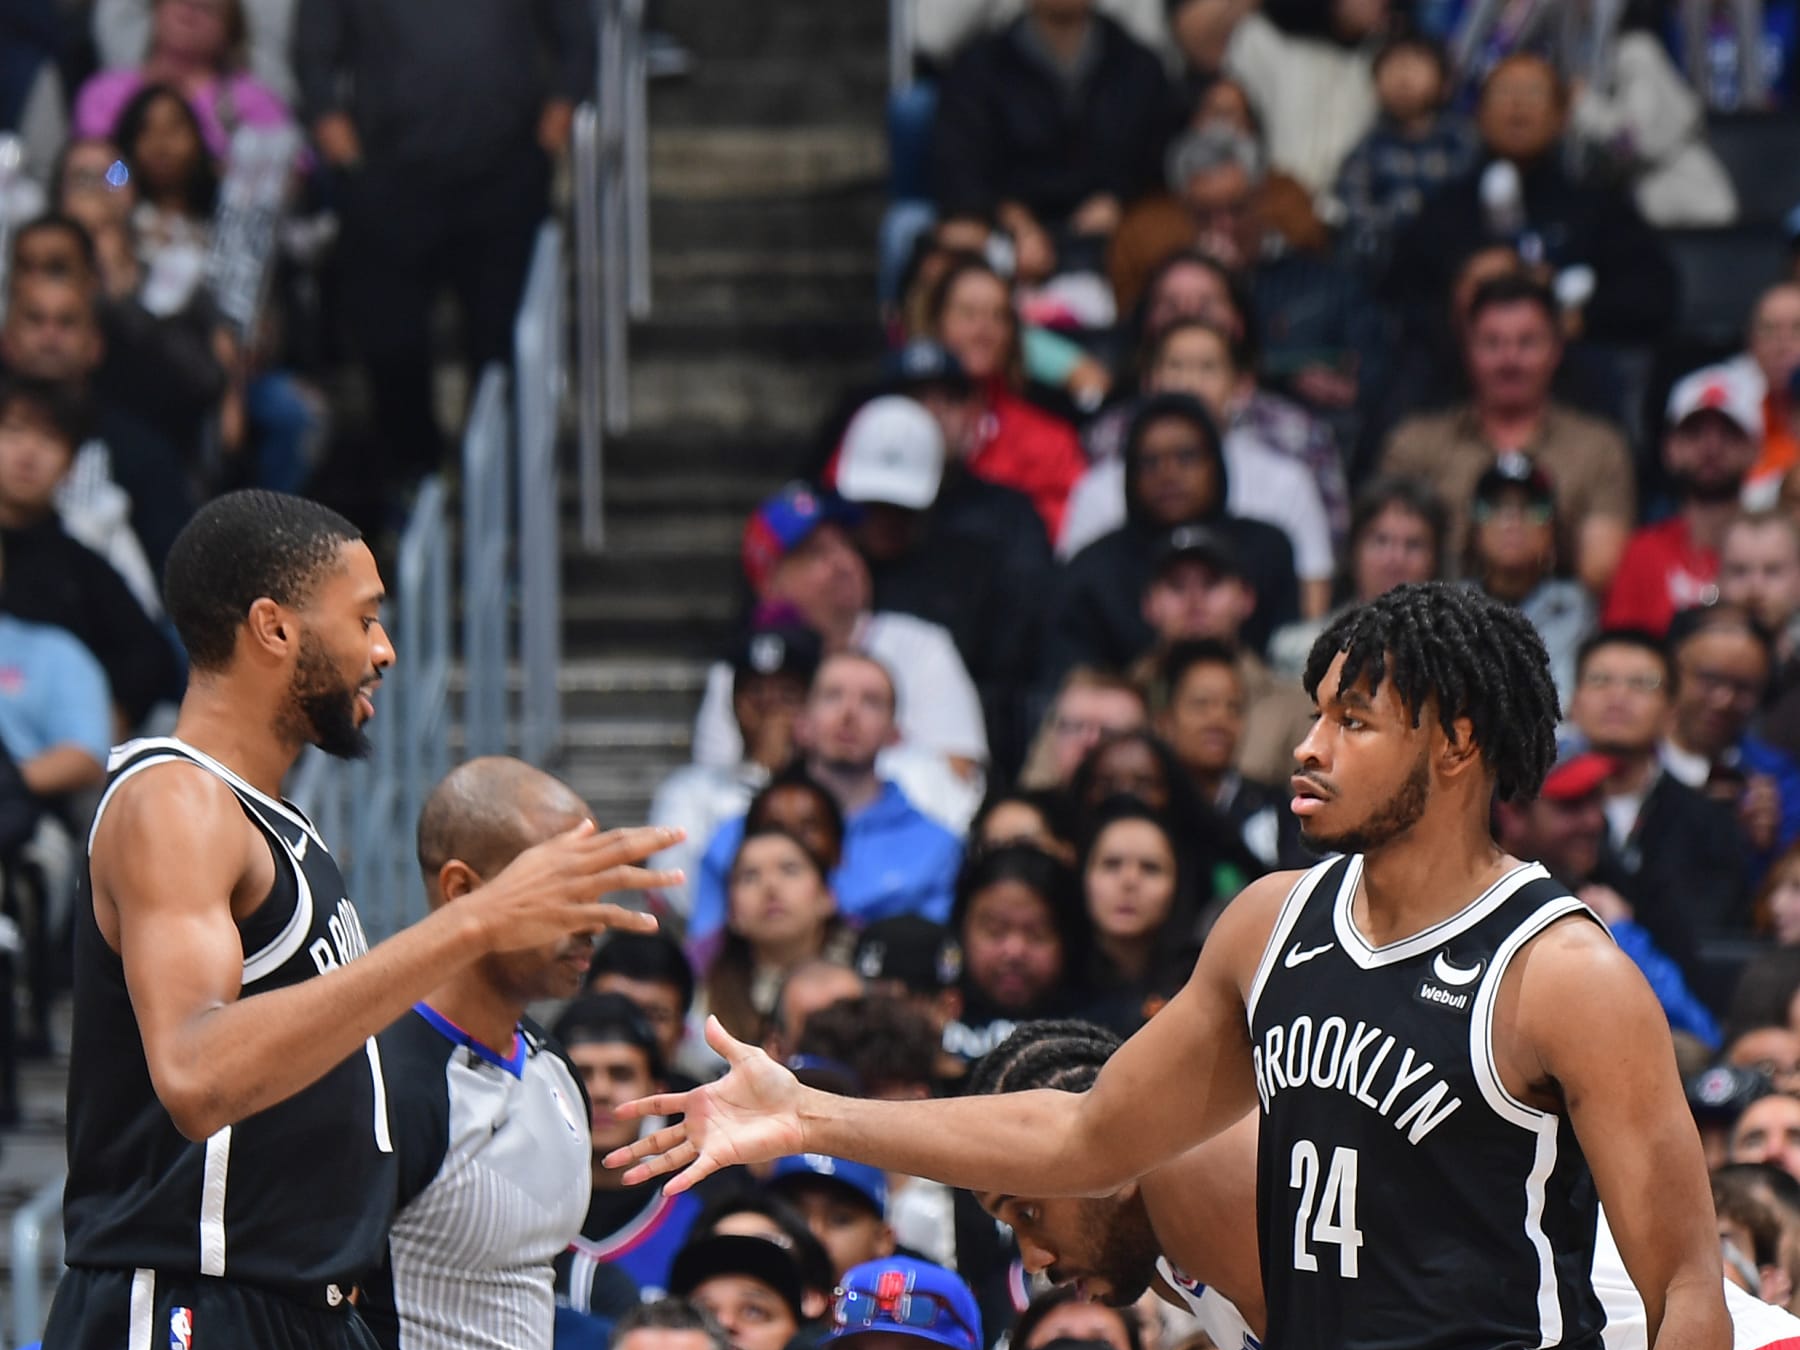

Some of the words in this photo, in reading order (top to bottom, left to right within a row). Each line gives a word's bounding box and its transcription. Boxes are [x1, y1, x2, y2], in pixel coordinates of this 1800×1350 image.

[1420, 983, 1468, 1009] Webull
[1253, 1015, 1462, 1146] BROOKLYN
[1289, 1139, 1364, 1279] 24
